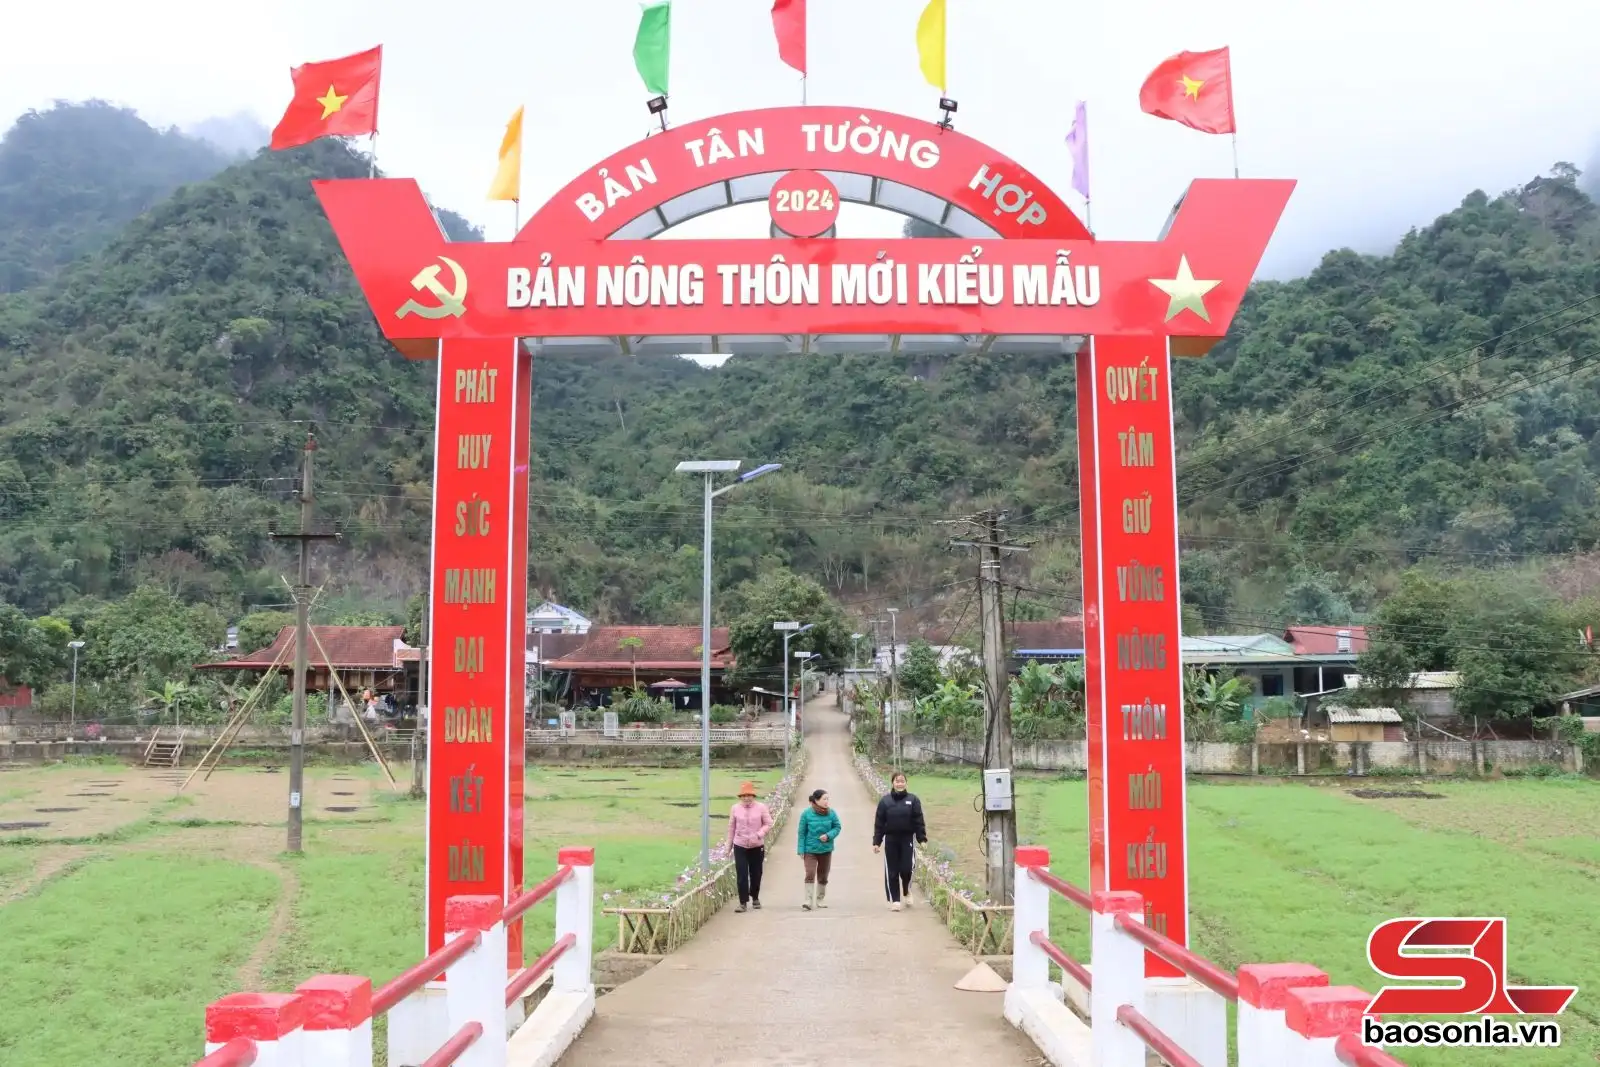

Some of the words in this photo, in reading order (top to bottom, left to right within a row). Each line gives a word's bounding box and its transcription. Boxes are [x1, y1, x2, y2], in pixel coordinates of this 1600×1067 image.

[575, 158, 658, 222] BẢN
[684, 127, 765, 167] TÂN
[802, 114, 940, 169] TƯỜNG
[968, 163, 1047, 226] HỢP
[776, 189, 834, 211] 2024
[507, 253, 585, 308] BẢN
[596, 256, 705, 308] NÔNG
[717, 257, 820, 307] THÔN
[831, 250, 909, 306] MỚI
[918, 245, 1004, 307] KIỂU
[1012, 249, 1101, 307] MẪU
[455, 362, 498, 403] PHÁT
[1105, 356, 1158, 404] QUYẾT
[457, 434, 492, 469] HUY
[1117, 426, 1154, 467] TÂM
[455, 492, 491, 537] SỨC
[1122, 490, 1152, 534] GIỮ
[444, 568, 497, 611] MẠNH
[1116, 560, 1164, 602] VỮNG
[454, 636, 484, 679] ĐẠI
[1117, 626, 1167, 671] NÔNG
[444, 700, 493, 743] ĐOÀN
[1120, 697, 1167, 741] THÔN
[449, 763, 484, 813] KẾT
[1128, 764, 1162, 810] MỚI
[448, 838, 485, 882] DÂN
[1126, 826, 1167, 880] KIỂU
